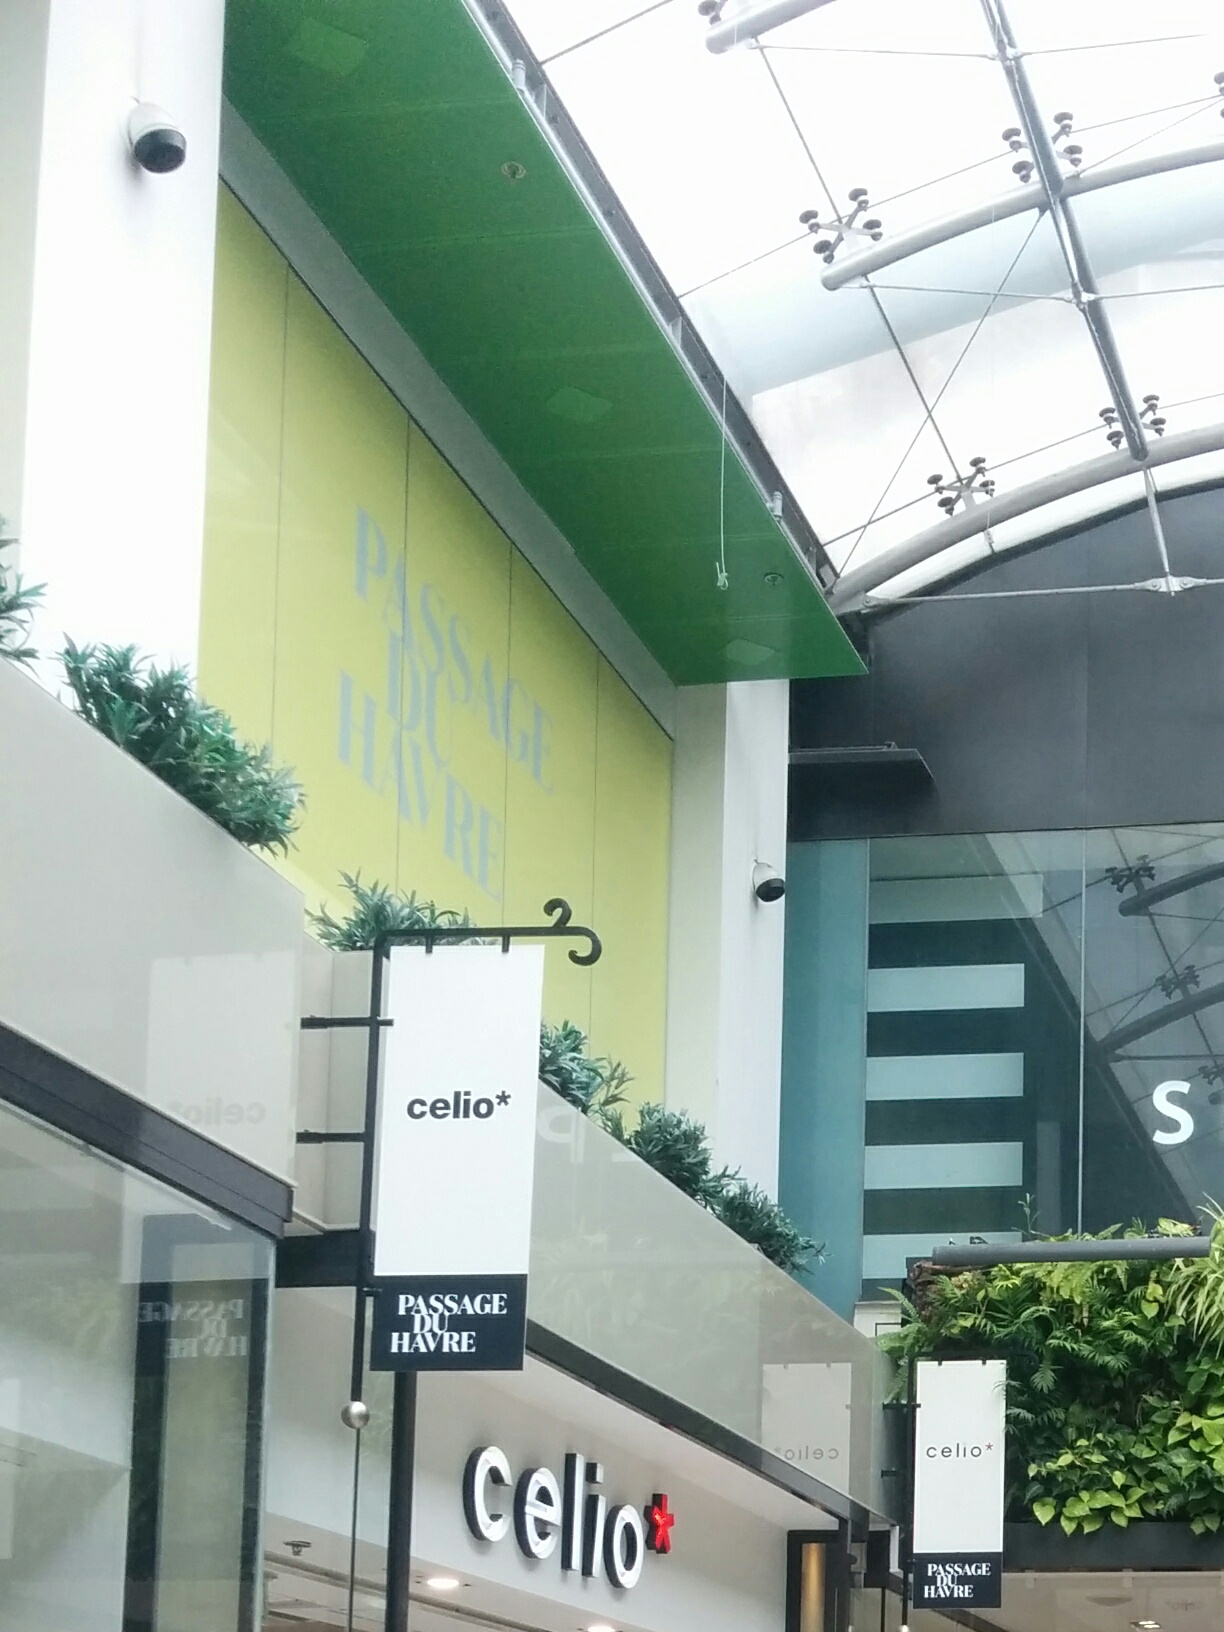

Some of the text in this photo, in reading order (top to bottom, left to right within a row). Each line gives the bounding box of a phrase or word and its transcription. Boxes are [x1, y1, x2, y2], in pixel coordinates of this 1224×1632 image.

[354, 504, 556, 796] PASSAGE
[386, 626, 450, 770] DU
[338, 668, 502, 902] HAVRE
[397, 1293, 508, 1316] PASSAGE
[412, 1313, 449, 1335] DU
[390, 1332, 476, 1354] HAVRE
[927, 1562, 991, 1577] PASSAGE
[936, 1574, 957, 1587] DU
[924, 1585, 974, 1598] HAVRE
